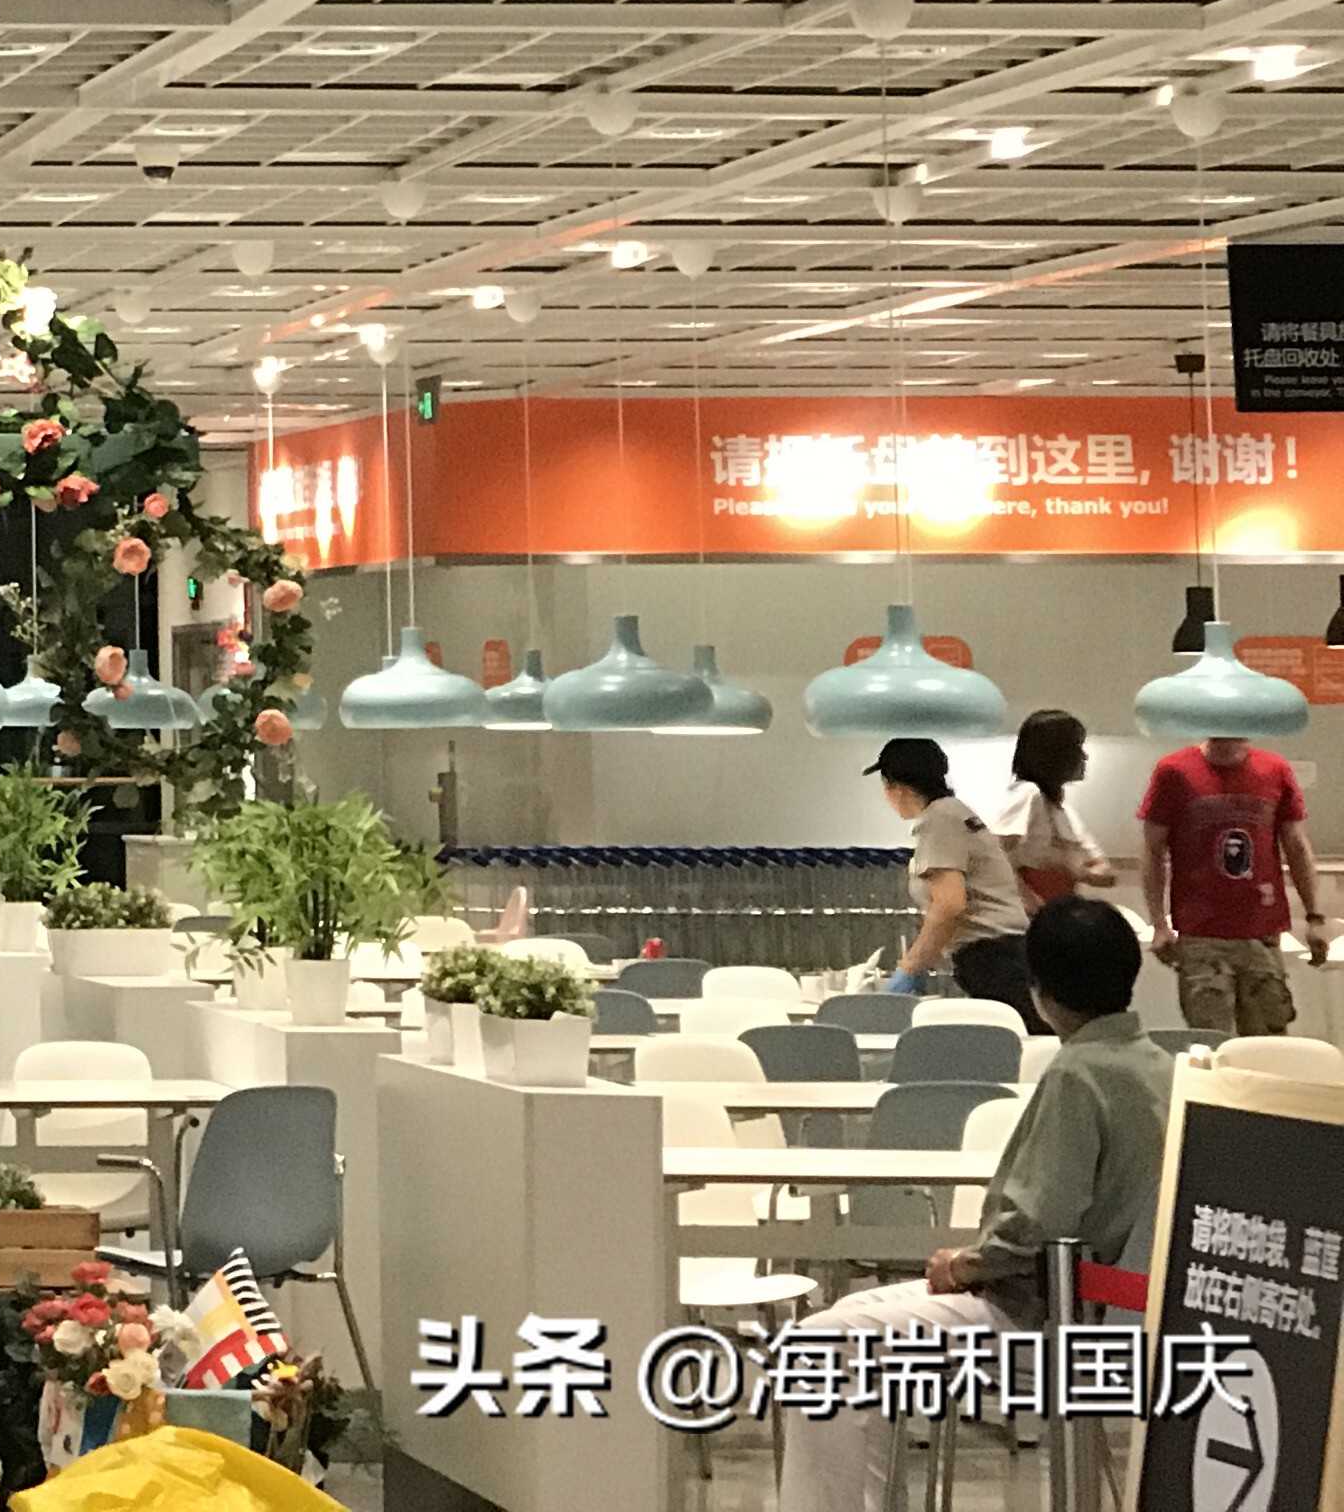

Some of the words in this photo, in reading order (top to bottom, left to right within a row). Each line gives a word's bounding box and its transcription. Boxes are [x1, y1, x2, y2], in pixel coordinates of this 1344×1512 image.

[1260, 321, 1344, 343] 请将餐具
[1046, 497, 1111, 515] thank
[1120, 497, 1168, 518] you!
